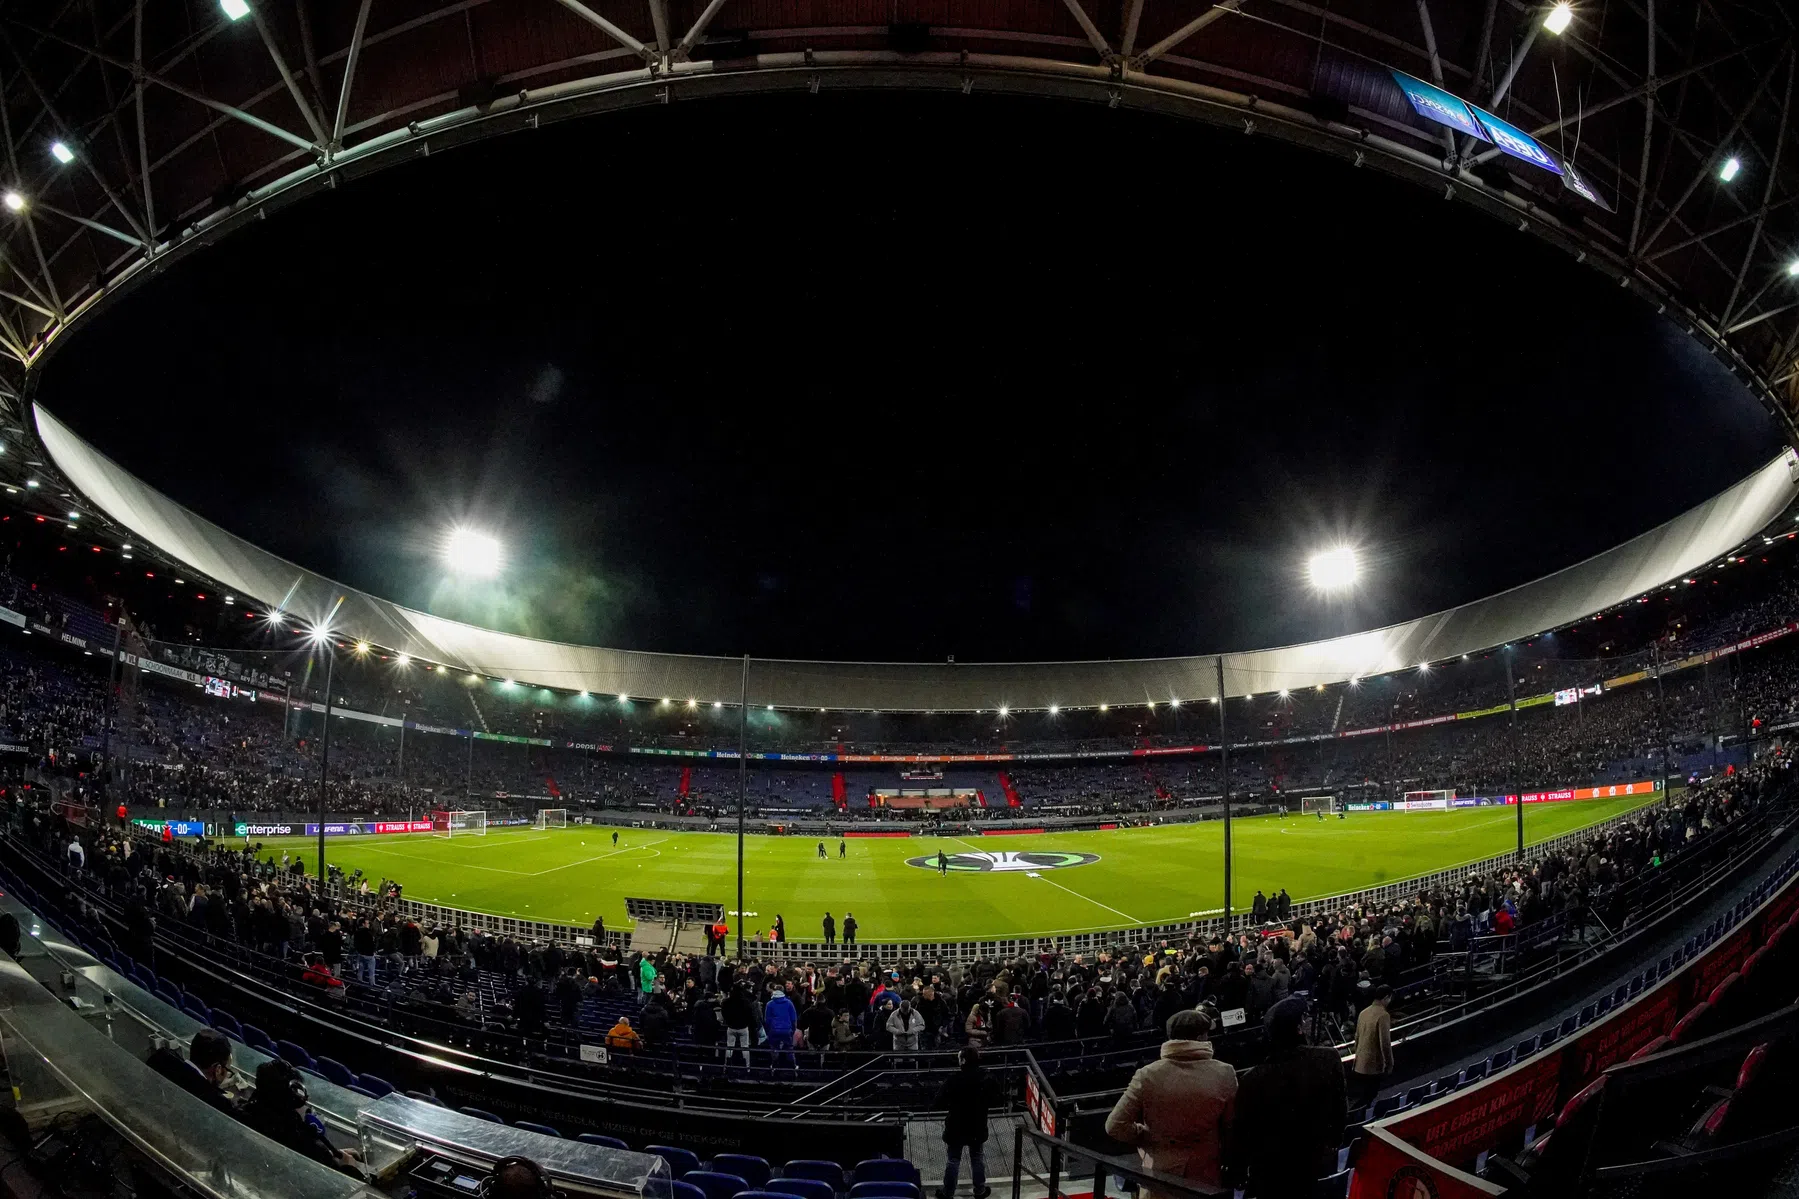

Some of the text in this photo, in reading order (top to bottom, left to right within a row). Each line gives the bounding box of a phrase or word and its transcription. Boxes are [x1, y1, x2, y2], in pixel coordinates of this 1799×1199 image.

[61, 632, 87, 649] HELMINK
[100, 647, 115, 656] HELMIN
[145, 660, 184, 679] SCHOONMAAK
[575, 743, 596, 751] pepsi
[1548, 792, 1571, 800] STRAUSS
[237, 823, 291, 836] enterprise
[386, 822, 431, 831] STRAUSS STRAUSS
[1425, 1120, 1448, 1144] UIT
[1450, 1102, 1488, 1132] EIGEN
